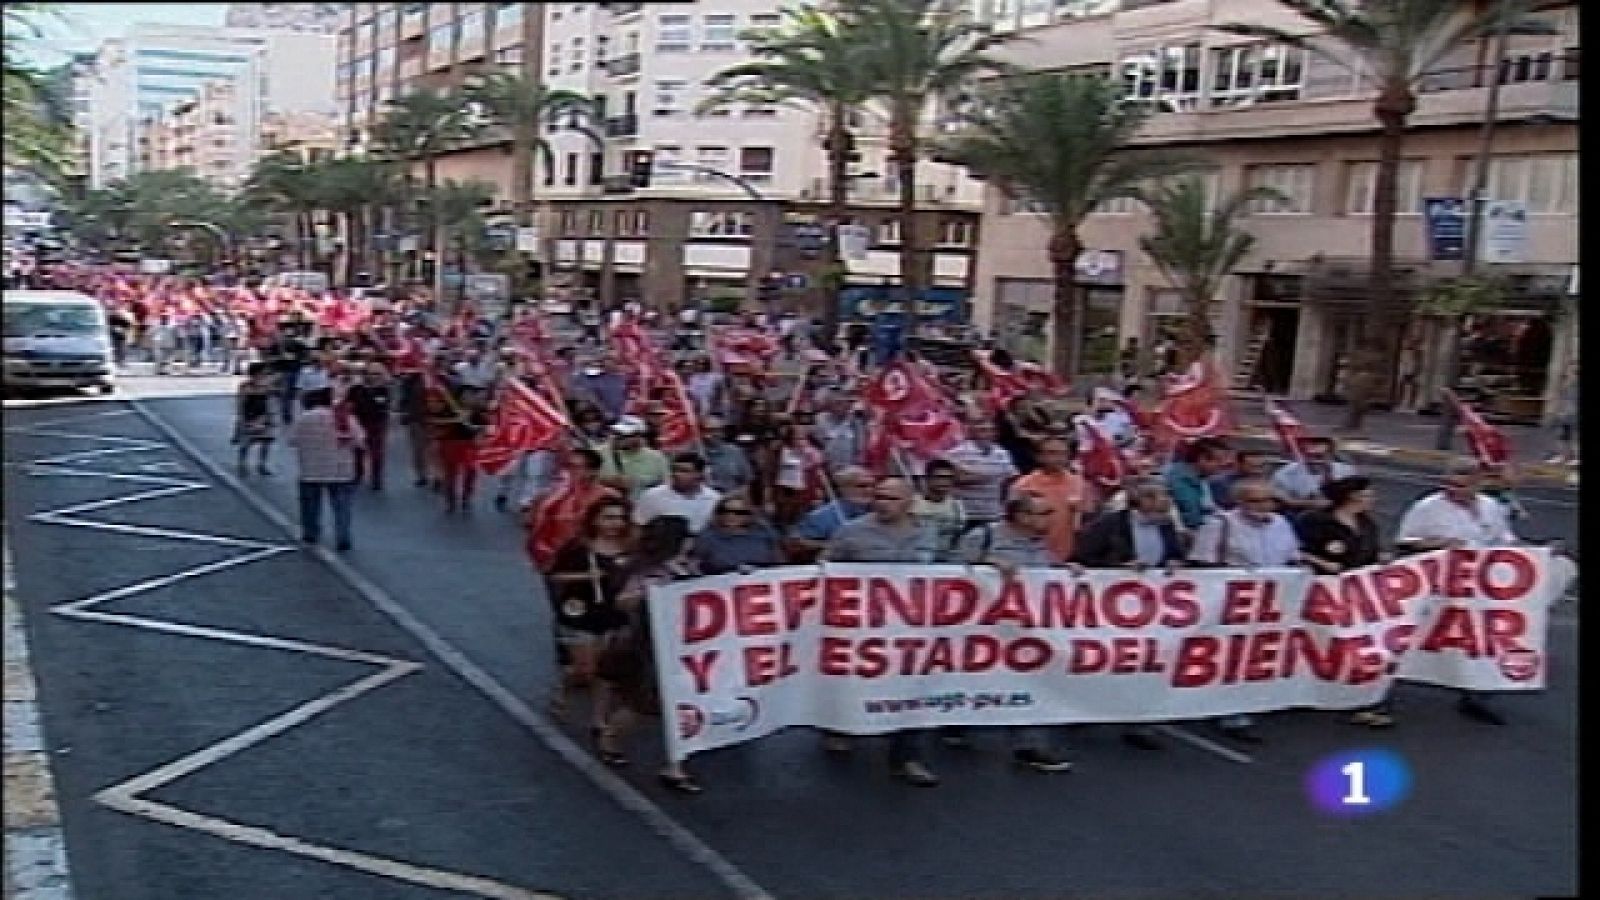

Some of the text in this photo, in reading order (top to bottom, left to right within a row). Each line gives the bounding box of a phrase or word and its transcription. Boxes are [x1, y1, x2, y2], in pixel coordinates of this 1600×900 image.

[683, 577, 1200, 643] DEFENDAMOS
[1221, 579, 1282, 625] EL
[680, 650, 720, 694] Y
[745, 642, 798, 686] EL
[820, 635, 1053, 677] ESTADO
[1067, 637, 1165, 673] DEL
[1171, 605, 1527, 690] BIENEAR
